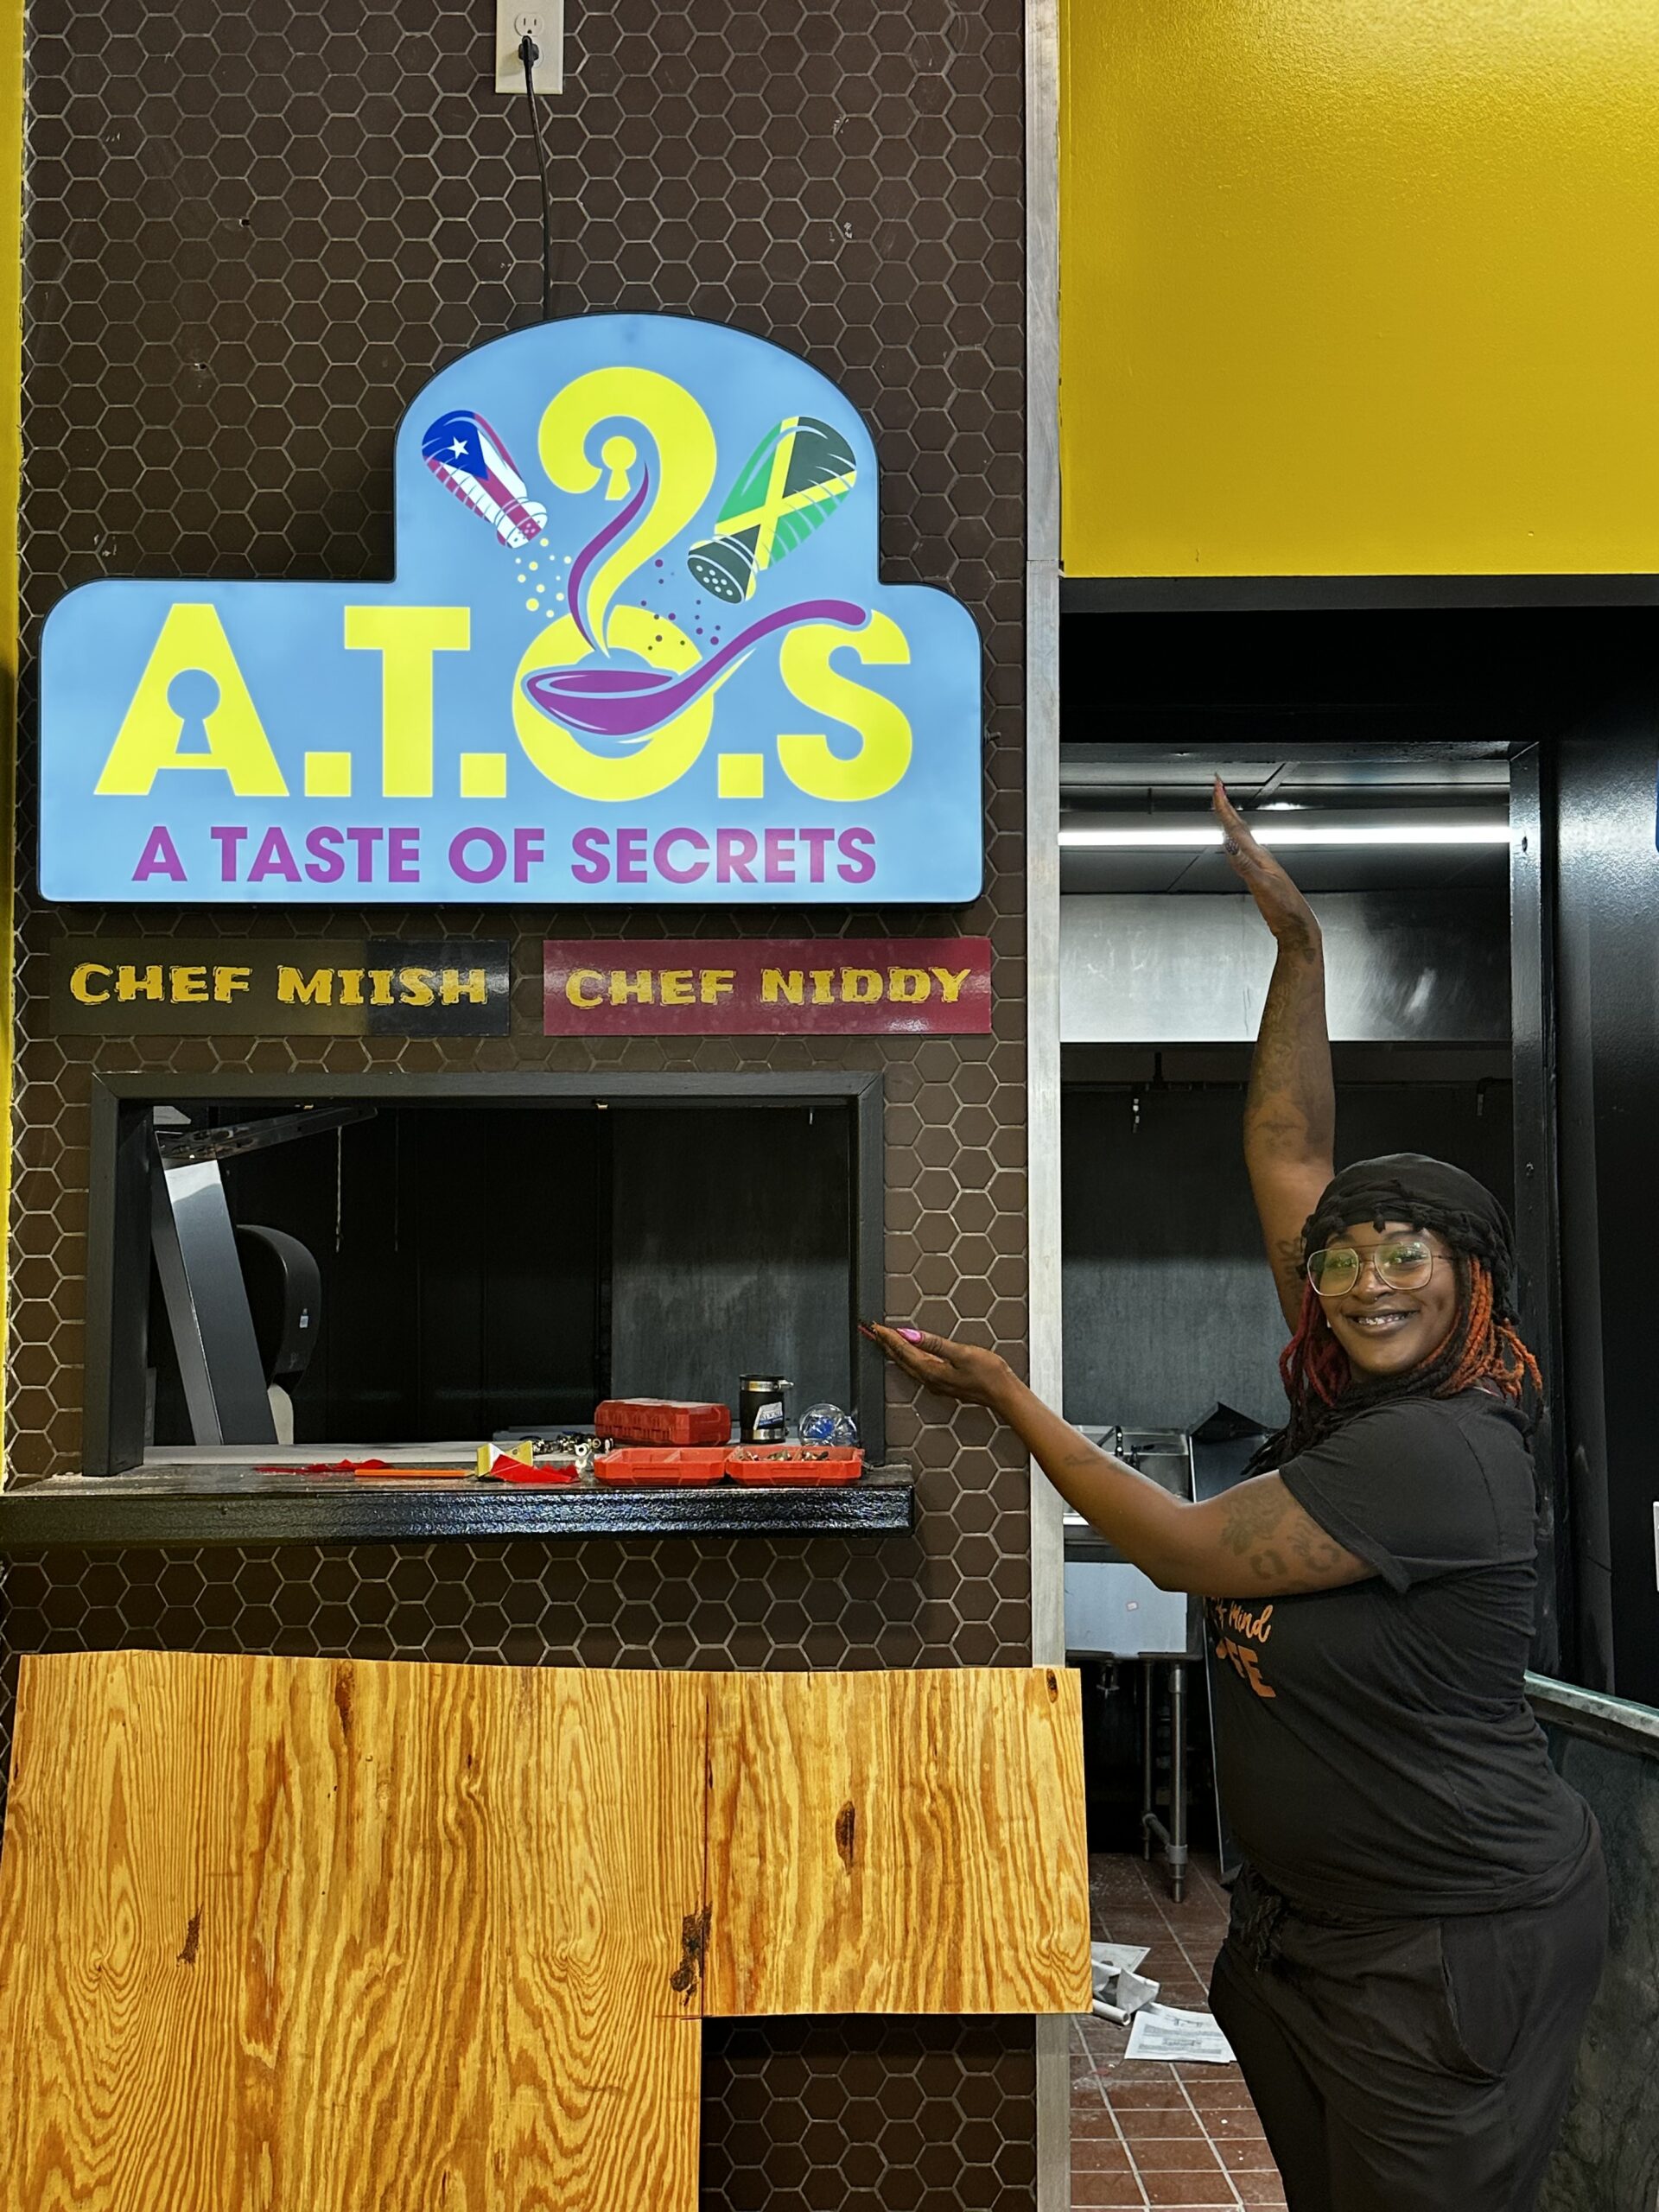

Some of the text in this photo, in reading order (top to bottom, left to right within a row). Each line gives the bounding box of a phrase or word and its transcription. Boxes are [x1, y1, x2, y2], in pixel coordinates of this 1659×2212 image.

[132, 825, 877, 884] A TASTE OF SECRETS
[69, 962, 487, 1007] CHEF MIISH
[564, 966, 972, 1008] CHEF NIDDY
